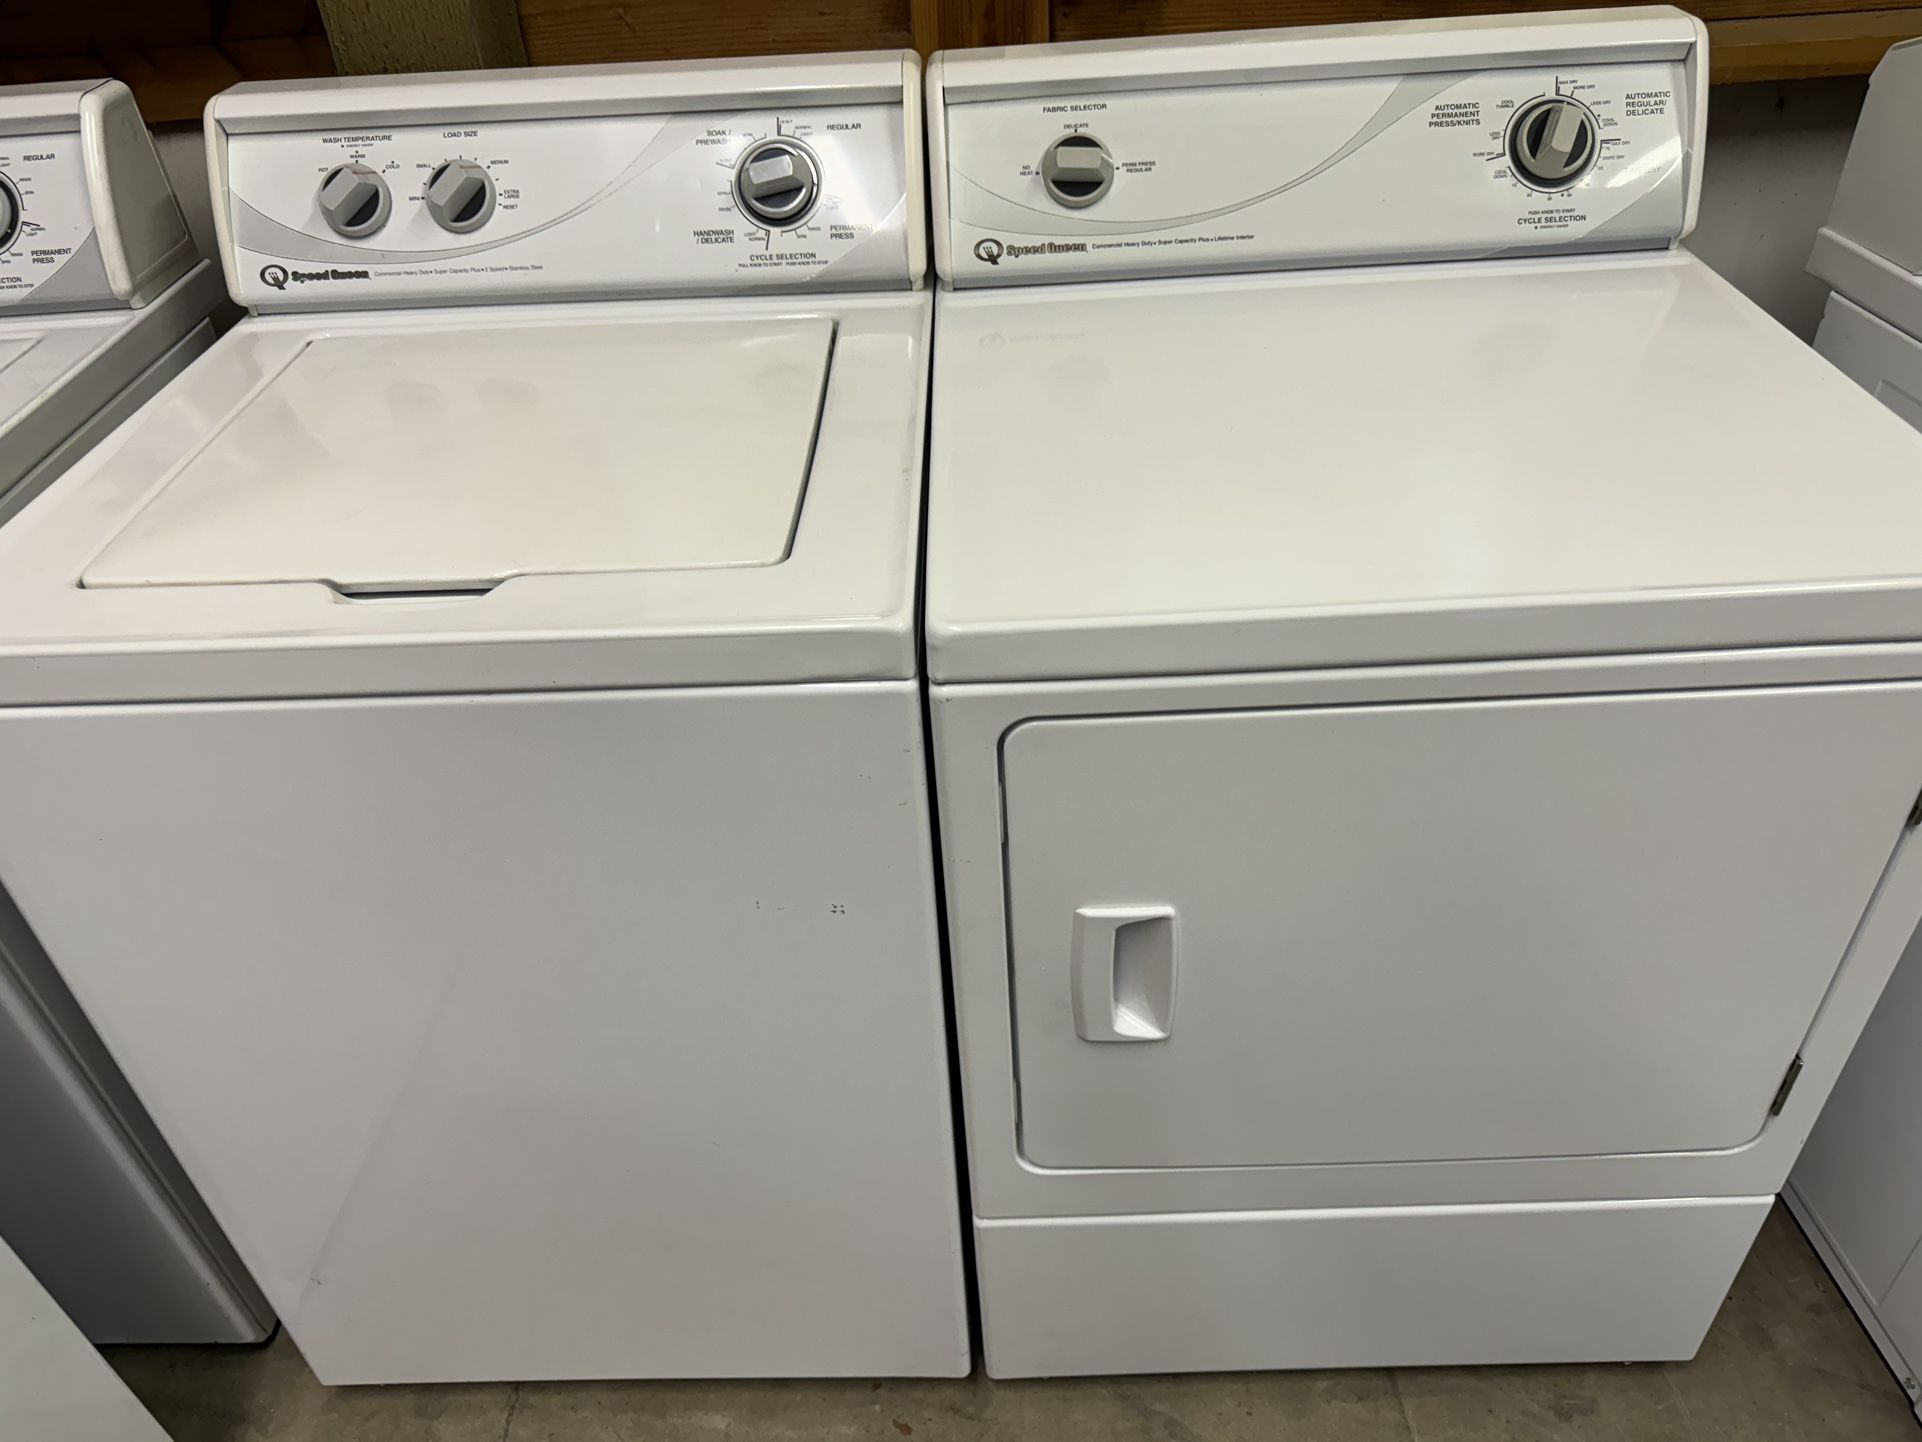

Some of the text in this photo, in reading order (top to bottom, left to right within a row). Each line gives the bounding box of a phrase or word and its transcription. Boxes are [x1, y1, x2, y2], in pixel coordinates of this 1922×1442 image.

[1625, 91, 1671, 100] AUTOMATIC
[1435, 102, 1480, 111] AUTOMATIC
[1626, 100, 1667, 108] REGULAR/
[1431, 111, 1480, 120] PERMANENT
[1626, 108, 1664, 116] DELICATE
[827, 123, 862, 131] REGULAR
[1429, 119, 1480, 128] PRESS/KNITS
[344, 135, 392, 143] TEMPERATURE
[23, 153, 55, 161] REGULAR
[1517, 215, 1587, 225] CYCLE SELECTION
[693, 229, 734, 237] HANDWASH
[701, 236, 734, 244] DELICATE
[31, 248, 72, 256] PERMANENT
[1006, 242, 1088, 258] Speed Queen
[775, 252, 816, 260] SELECTION
[0, 276, 22, 284] CTION
[291, 269, 371, 284] Speed Queen
